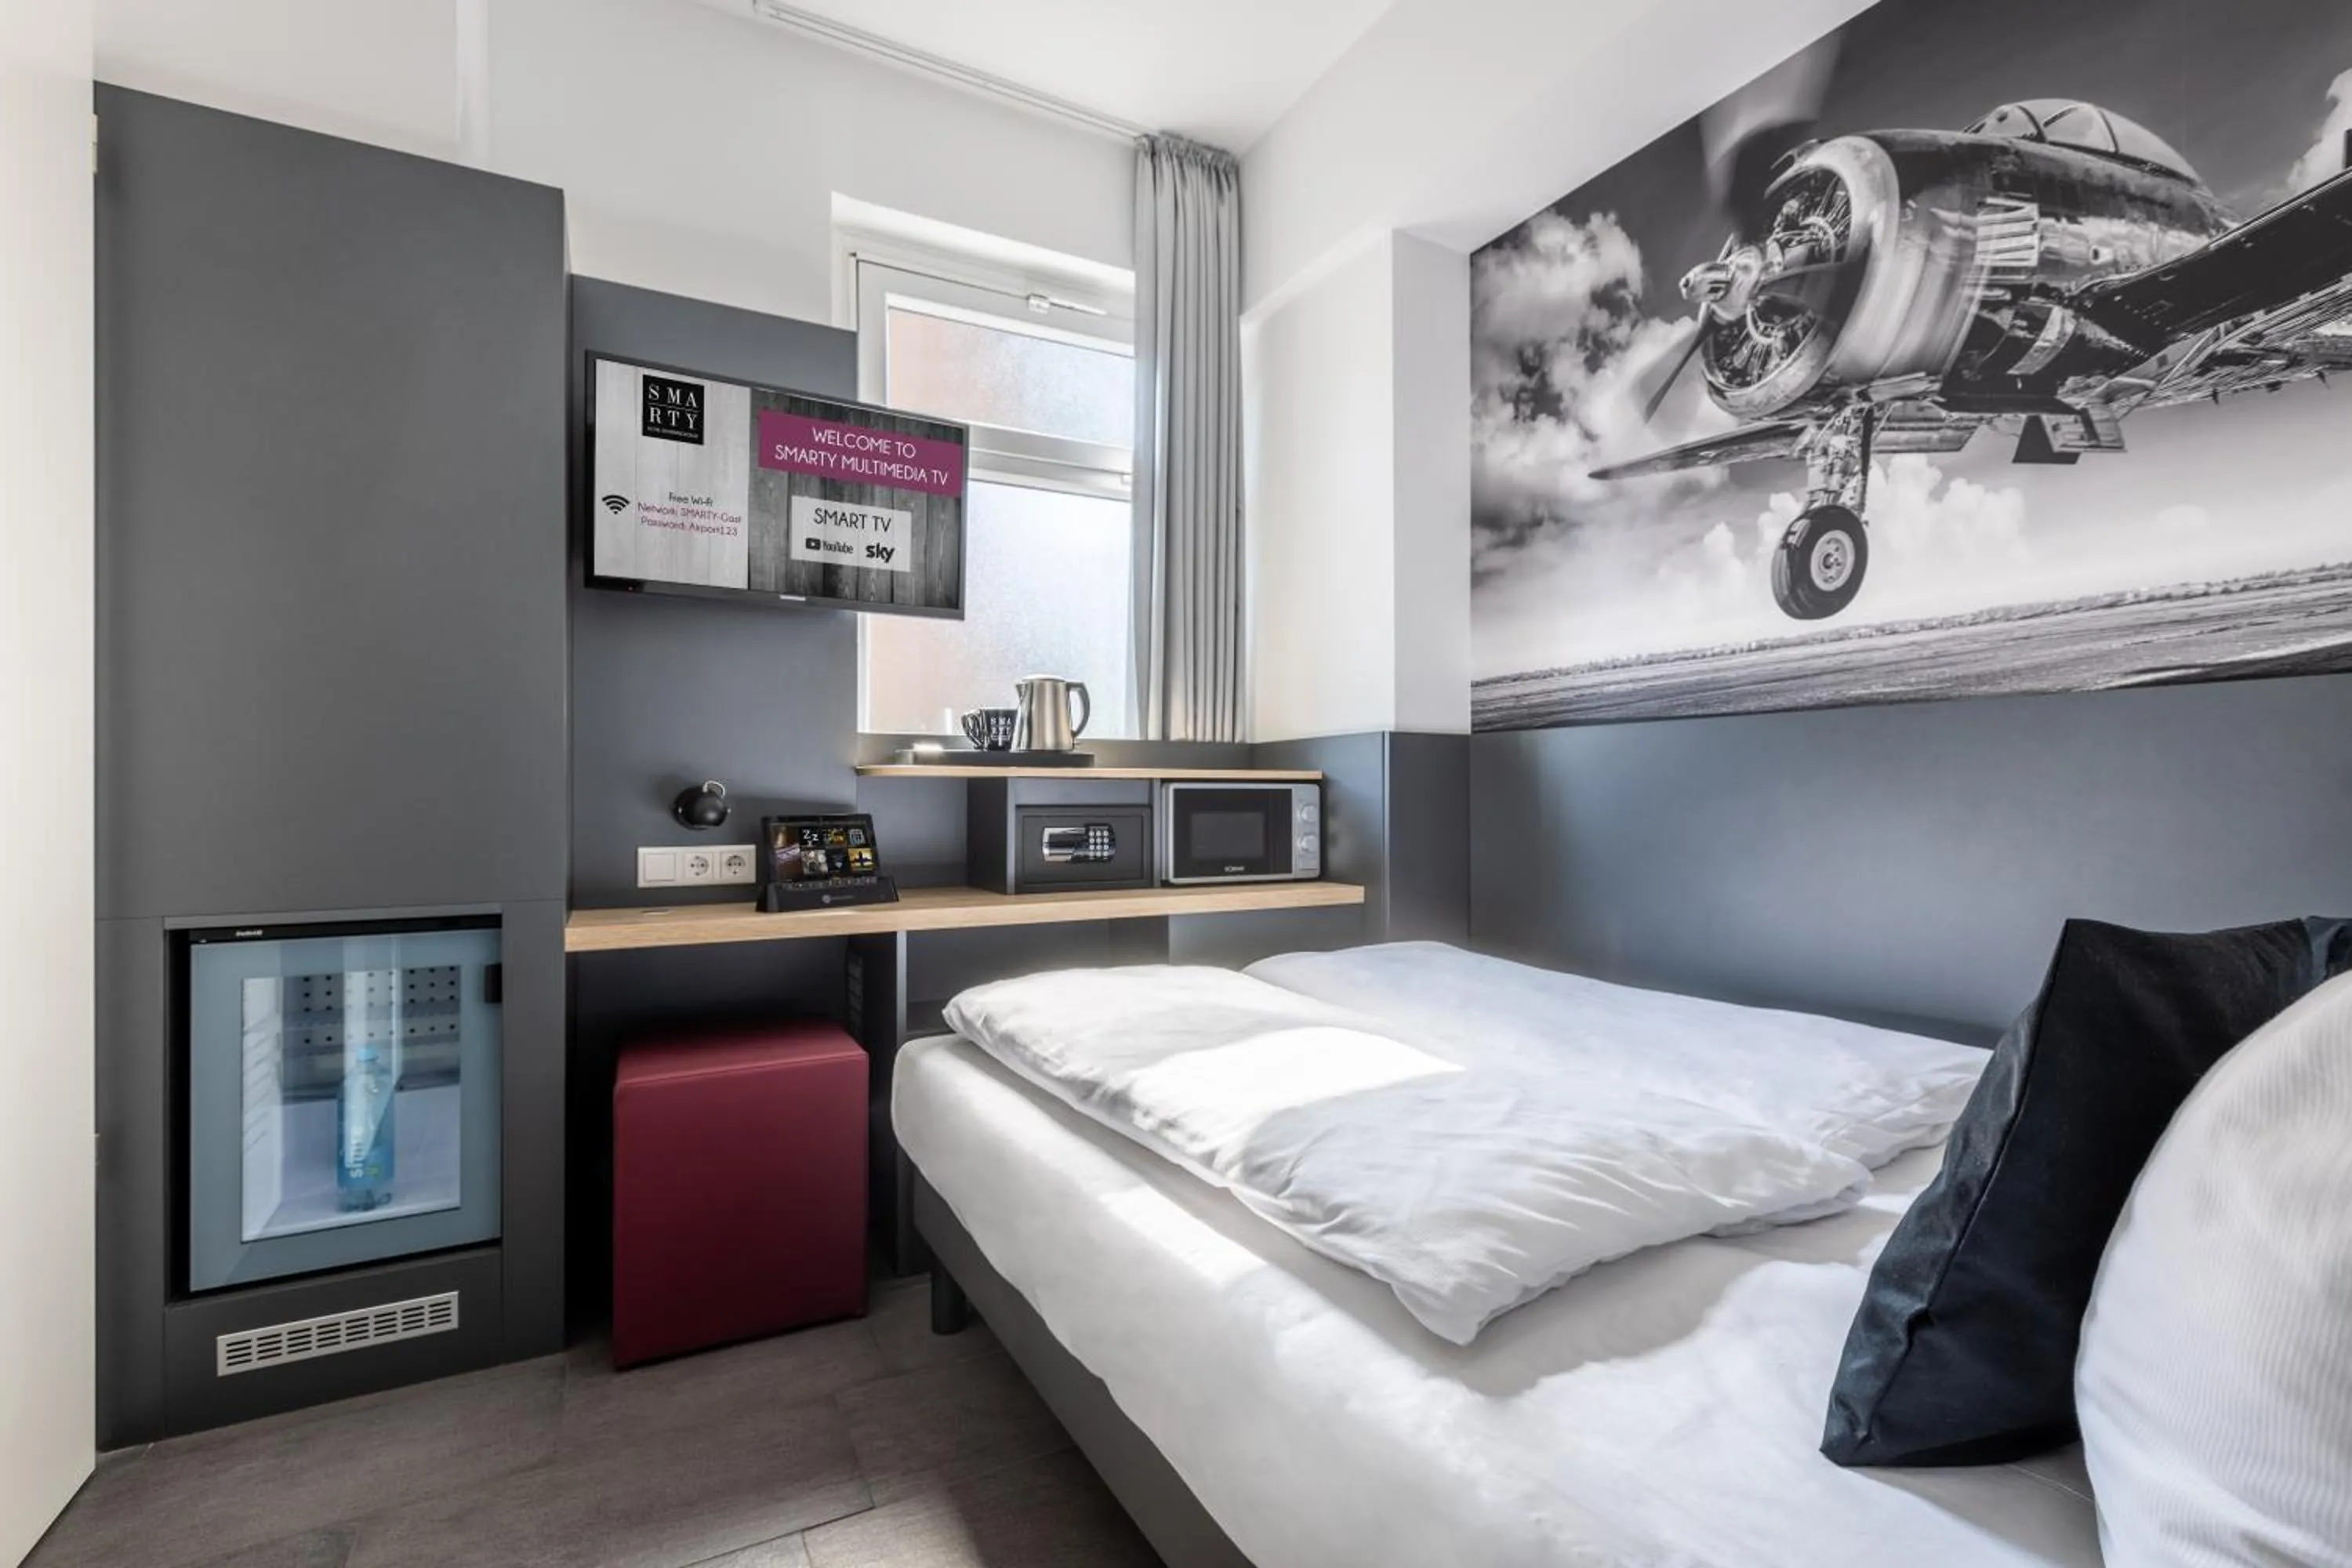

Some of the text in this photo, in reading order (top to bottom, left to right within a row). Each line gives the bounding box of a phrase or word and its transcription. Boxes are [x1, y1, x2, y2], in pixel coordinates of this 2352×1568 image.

[812, 426, 916, 459] WELCOME TO
[775, 445, 948, 486] SMARTY MULTIMEDIA TV
[669, 492, 689, 503] Free
[814, 508, 891, 532] SMART TV
[823, 540, 853, 554] YouTube
[866, 543, 895, 563] sky
